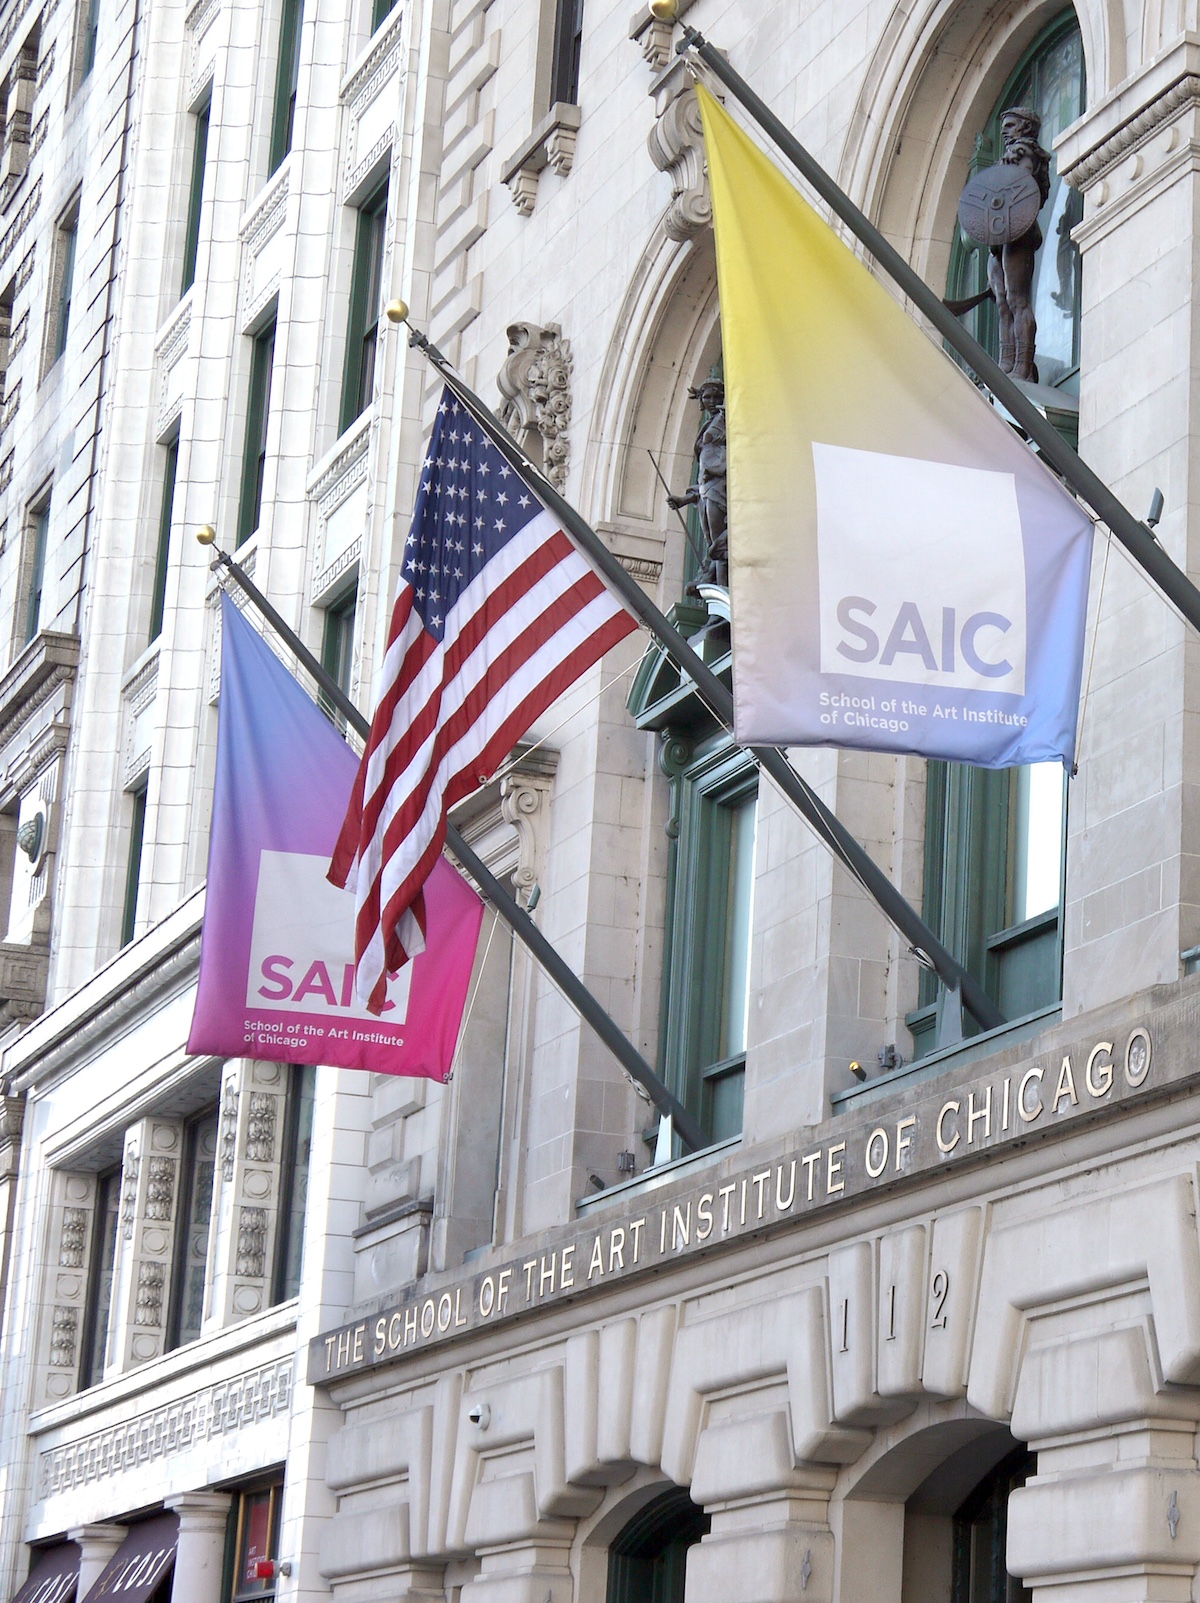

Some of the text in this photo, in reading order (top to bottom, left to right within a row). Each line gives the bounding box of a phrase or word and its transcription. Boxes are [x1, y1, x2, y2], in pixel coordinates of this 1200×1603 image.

[836, 596, 1014, 678] SAIC
[819, 692, 1028, 727] School of the Art Institute
[820, 711, 910, 733] of Chicago
[257, 954, 399, 1012] SAI
[243, 1033, 308, 1048] of Chicago
[244, 1019, 404, 1047] School of the Art Institute
[324, 1325, 366, 1372] THE
[374, 1288, 467, 1355] SCHOOL
[479, 1268, 513, 1318] OF
[523, 1243, 577, 1302] THE
[587, 1216, 647, 1281] ART
[660, 1139, 848, 1255] INSTITUTE
[864, 1115, 917, 1179] OF
[935, 1026, 1153, 1154] CHICAGO
[839, 1269, 950, 1353] 112
